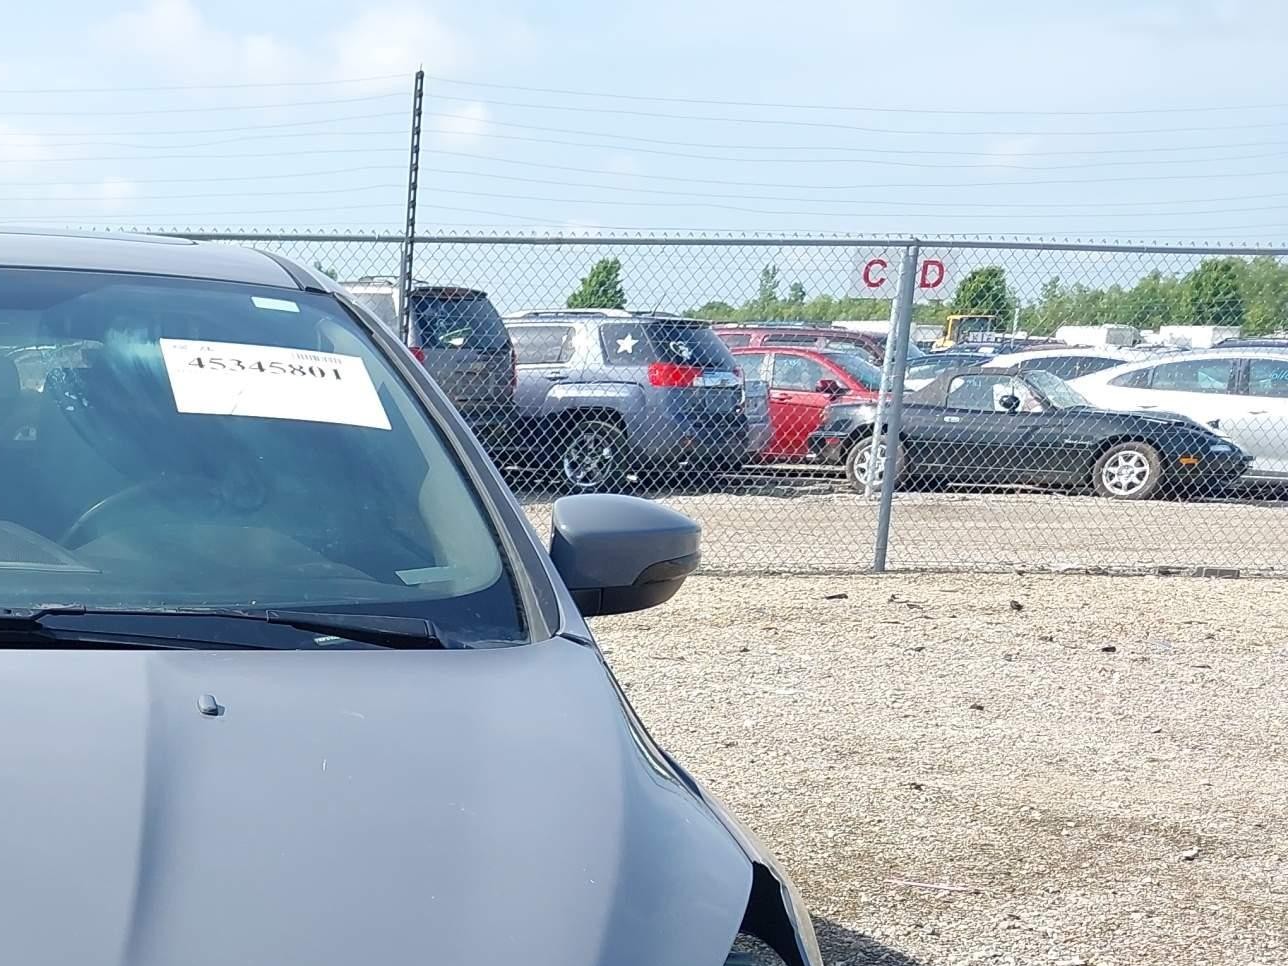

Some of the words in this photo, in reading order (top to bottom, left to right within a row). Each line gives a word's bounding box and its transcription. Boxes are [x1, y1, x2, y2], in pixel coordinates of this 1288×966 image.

[863, 259, 887, 288] C
[920, 260, 944, 288] D
[187, 356, 342, 381] 45345801
